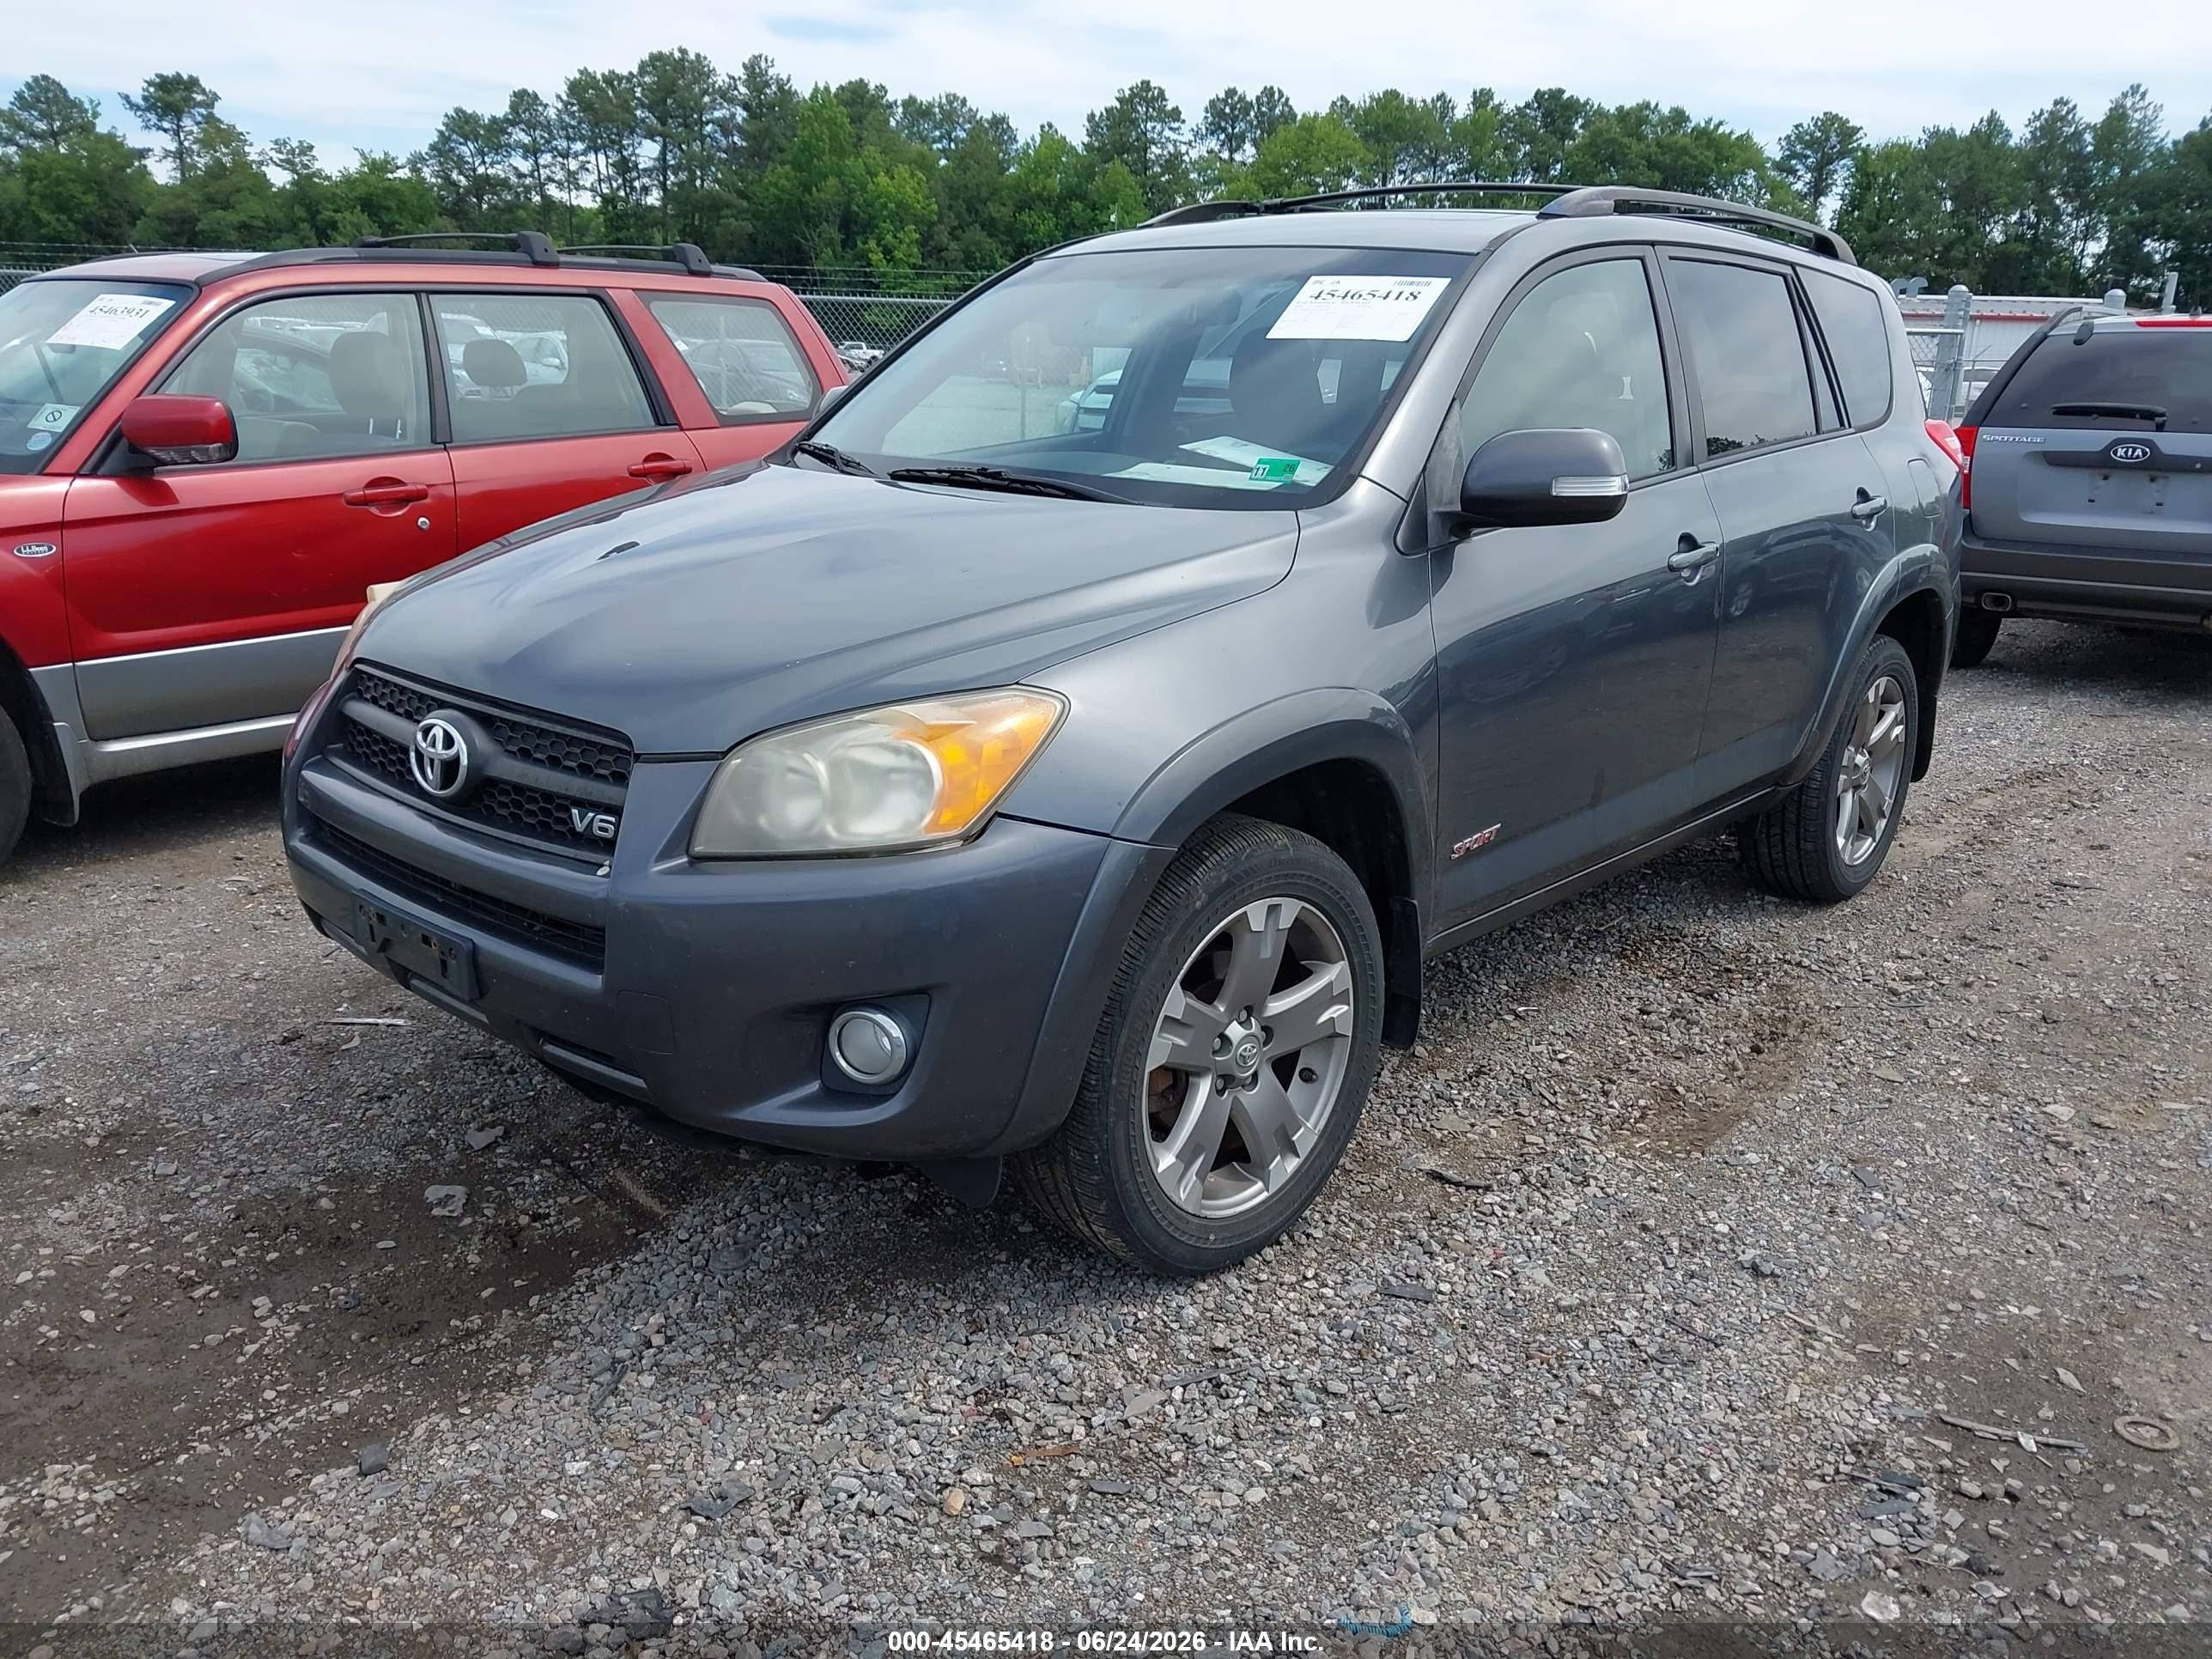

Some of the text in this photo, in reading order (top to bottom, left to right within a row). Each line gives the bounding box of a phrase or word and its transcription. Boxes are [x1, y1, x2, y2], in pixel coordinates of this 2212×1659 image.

[1309, 289, 1422, 301] 45465418
[88, 305, 150, 319] 45463931
[1982, 434, 2046, 443] SPORTAGE
[2117, 447, 2143, 459] KIA
[1254, 465, 1267, 477] 11
[571, 808, 616, 839] V6
[1450, 823, 1502, 860] SPORT
